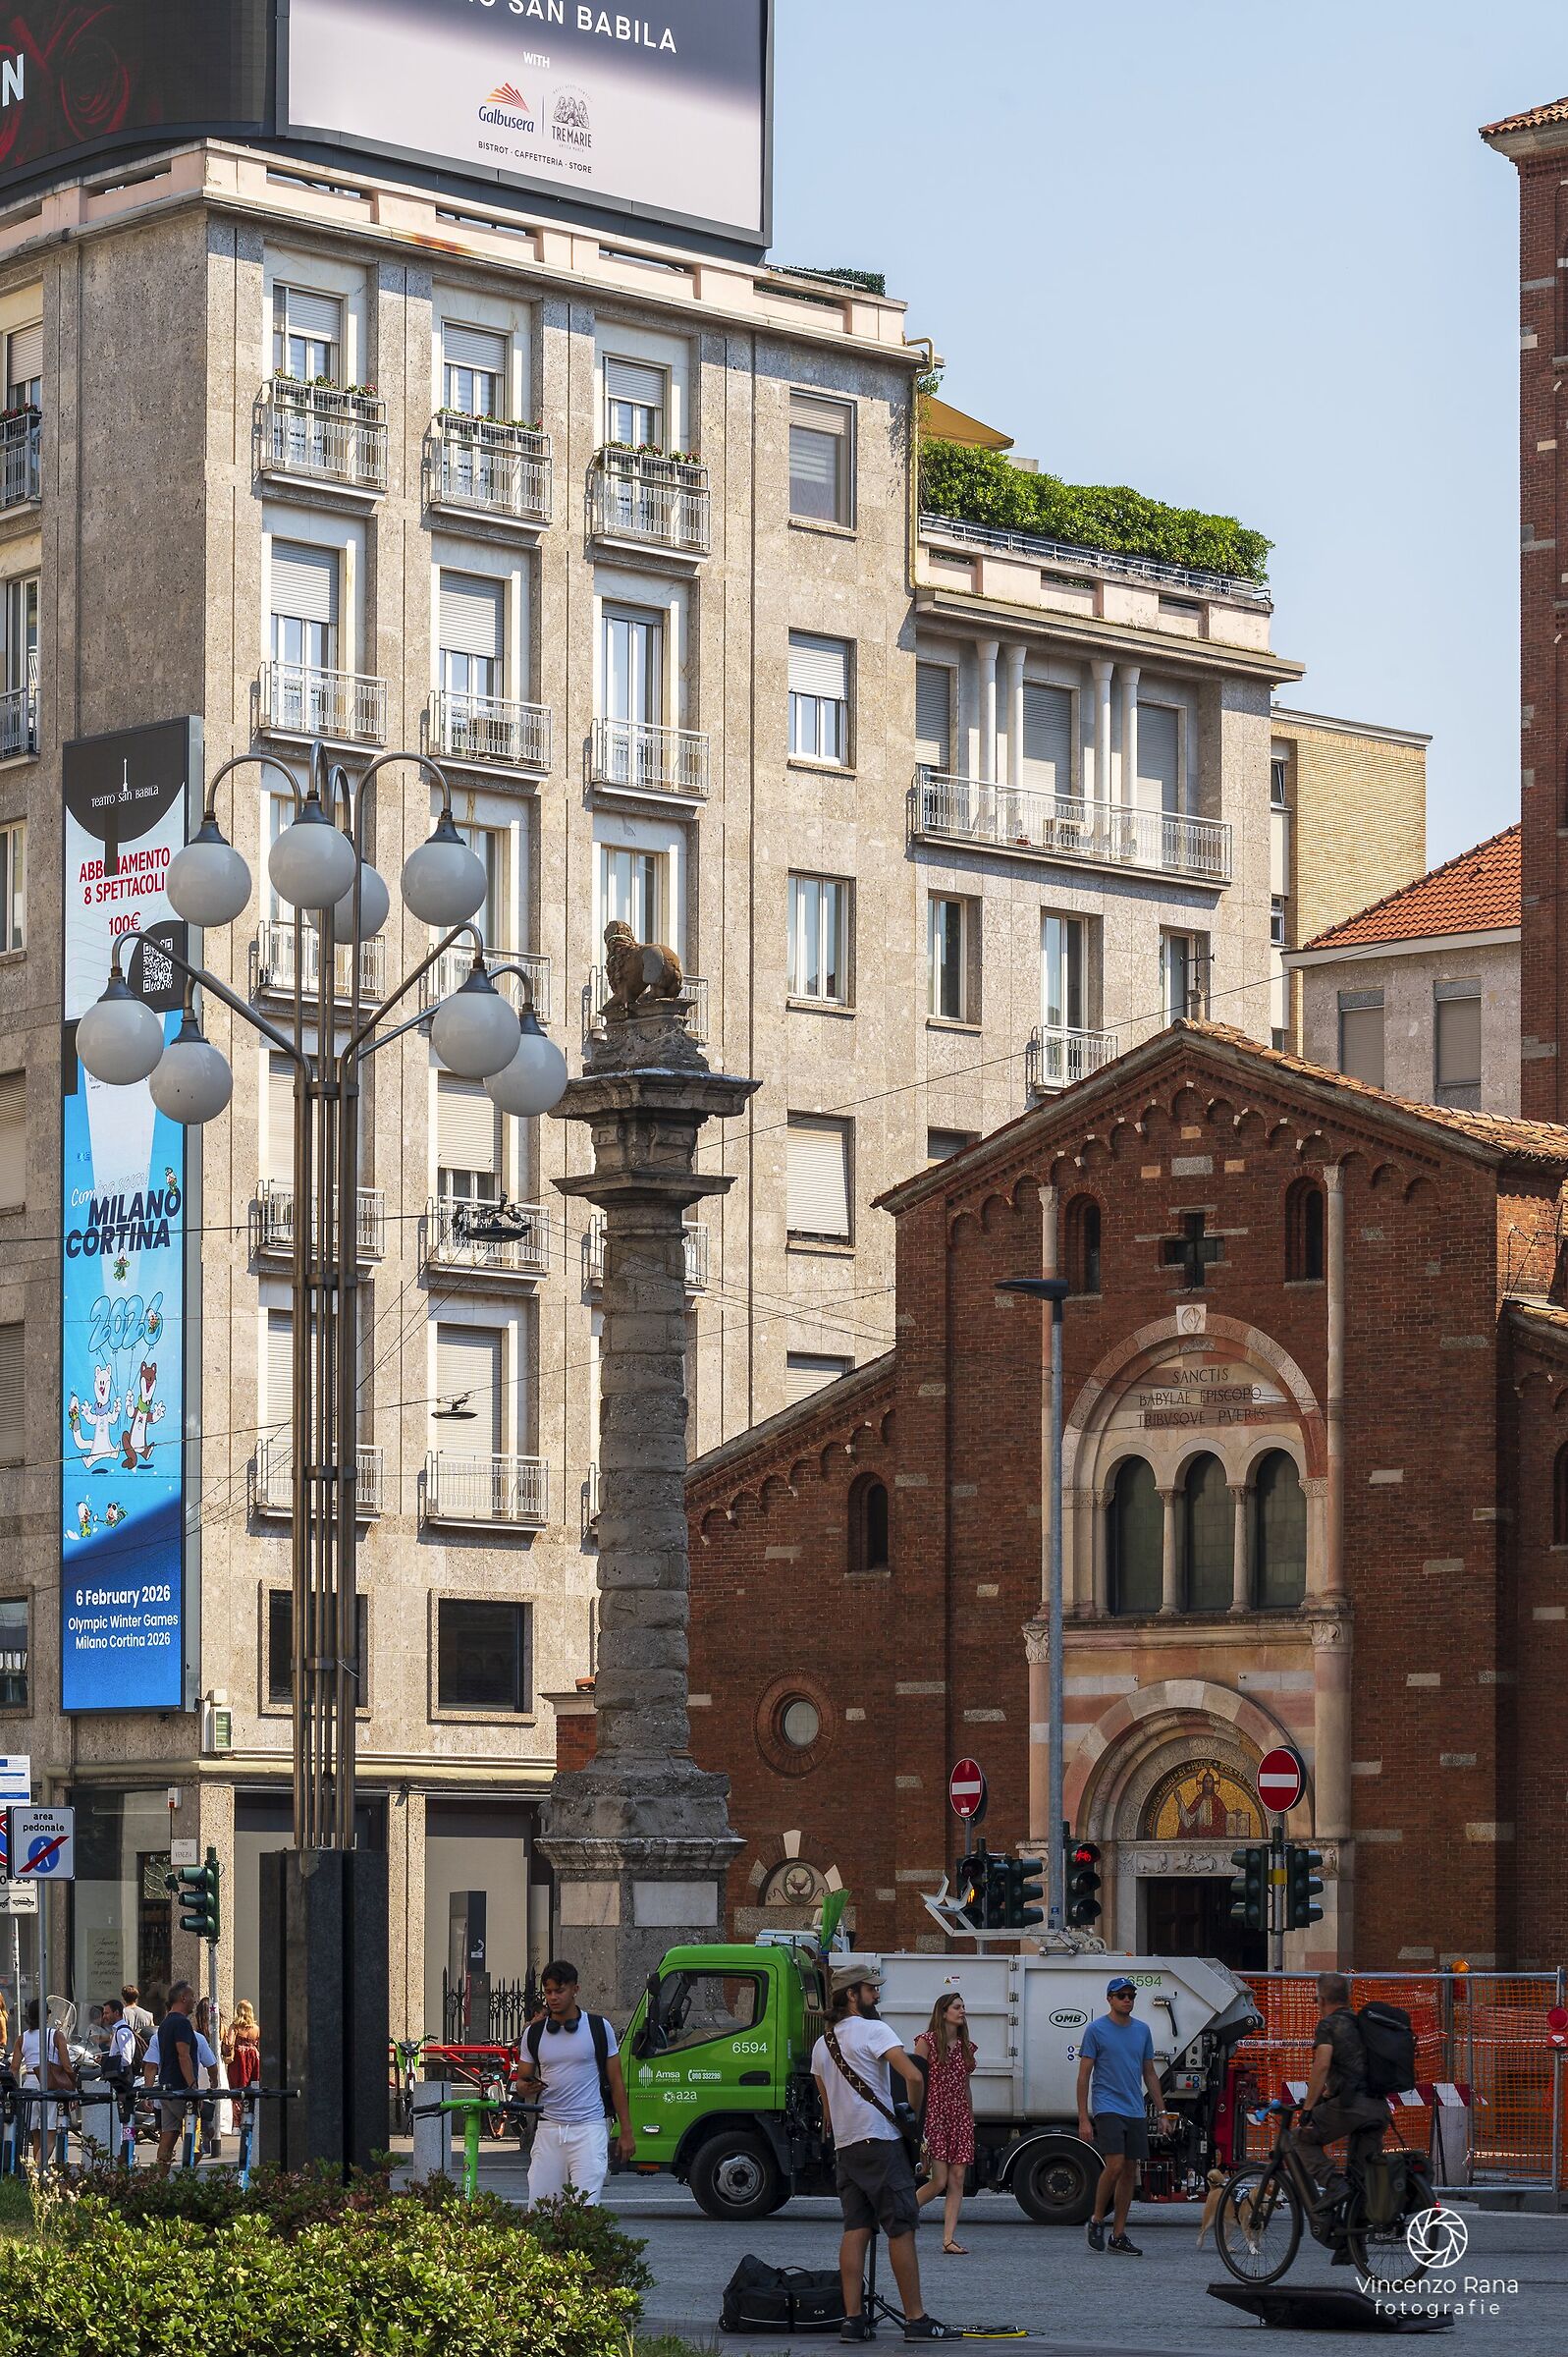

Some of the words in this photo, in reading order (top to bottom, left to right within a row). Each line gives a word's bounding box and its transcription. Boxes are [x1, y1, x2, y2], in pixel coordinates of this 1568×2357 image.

[509, 0, 564, 25] SAN
[577, 5, 677, 54] BABILA
[523, 51, 551, 69] WITH
[478, 105, 535, 133] Galbusera
[478, 140, 509, 155] BISTROT
[514, 149, 564, 168] CAFFETTERIA
[568, 161, 592, 174] STORE
[80, 847, 171, 882] ABBAMENTO
[83, 886, 92, 905] 8
[96, 871, 165, 904] SPETTACOLI
[109, 911, 141, 936] 100€
[87, 1185, 182, 1228] MILANO
[66, 1218, 171, 1258] CORTINA
[88, 1291, 163, 1353] 2026
[1172, 1367, 1229, 1384] SANCTIS
[1139, 1391, 1191, 1406] BABYLAE
[1200, 1387, 1262, 1402] EPISCOPO
[1217, 1407, 1266, 1423] PVERIS
[76, 1589, 83, 1606] 6
[85, 1588, 140, 1609] February
[141, 1584, 171, 1603] 2026
[68, 1616, 108, 1634] Olympic
[110, 1614, 141, 1628] Winter
[143, 1614, 179, 1627] Games
[76, 1635, 108, 1650] Milano
[109, 1633, 145, 1648] Cortina
[147, 1631, 171, 1646] 2026
[23, 1823, 65, 1833] pedonale
[1127, 1975, 1162, 1987] 6594
[1054, 2013, 1082, 2023] OMB
[731, 2042, 768, 2054] 6594
[655, 2069, 680, 2078] Amsa
[676, 2091, 698, 2101] a2a
